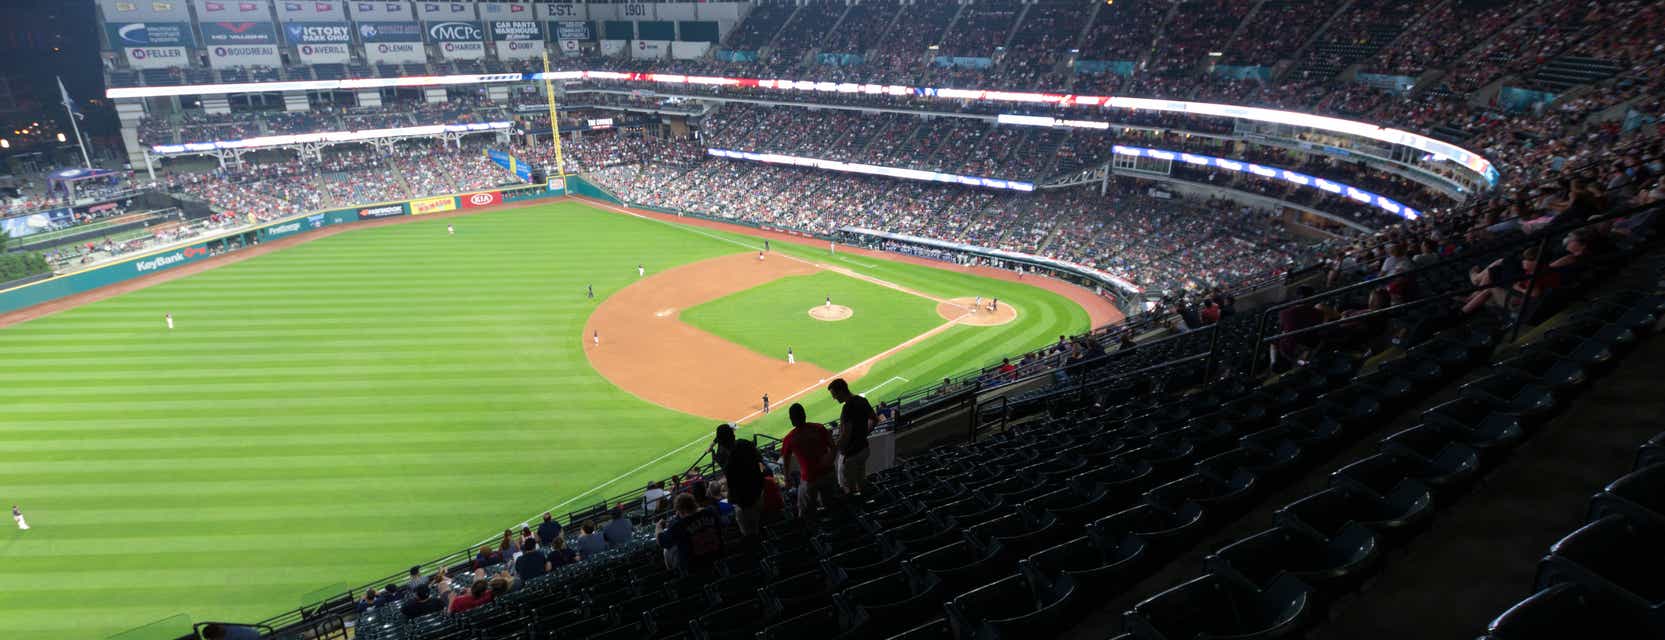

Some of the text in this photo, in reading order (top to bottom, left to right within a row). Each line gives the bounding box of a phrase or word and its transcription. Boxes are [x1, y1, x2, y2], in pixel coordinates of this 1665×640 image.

[548, 5, 577, 16] EST.
[625, 5, 646, 16] 1901
[146, 49, 181, 58] FELLER
[475, 195, 489, 204] KIA
[135, 252, 185, 271] KeyBank
